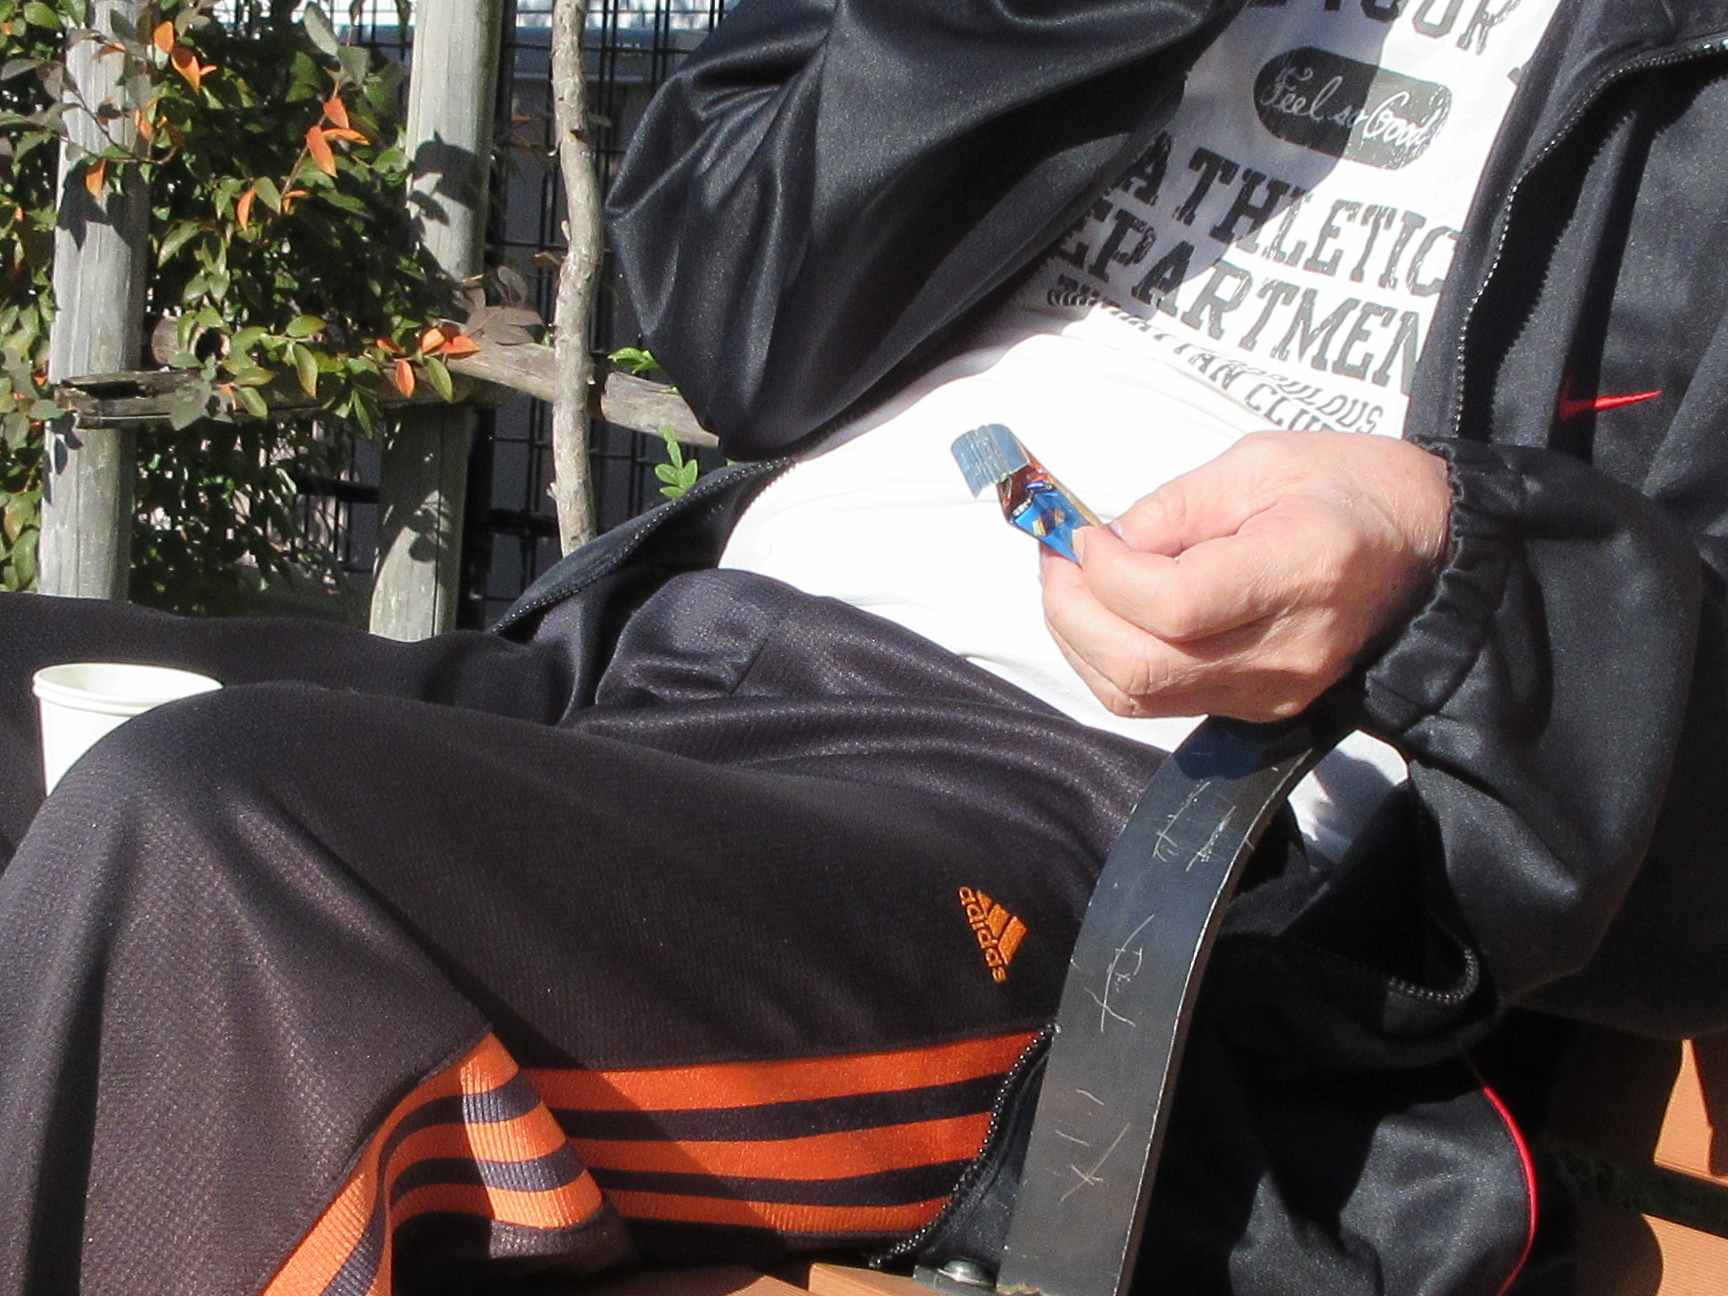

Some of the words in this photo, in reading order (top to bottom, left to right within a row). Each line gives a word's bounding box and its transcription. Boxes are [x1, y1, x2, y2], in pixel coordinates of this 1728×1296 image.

[1260, 65, 1343, 122] Feel
[1363, 90, 1449, 148] Good
[1055, 198, 1422, 398] EPARTMEN
[959, 885, 1008, 984] adidas
